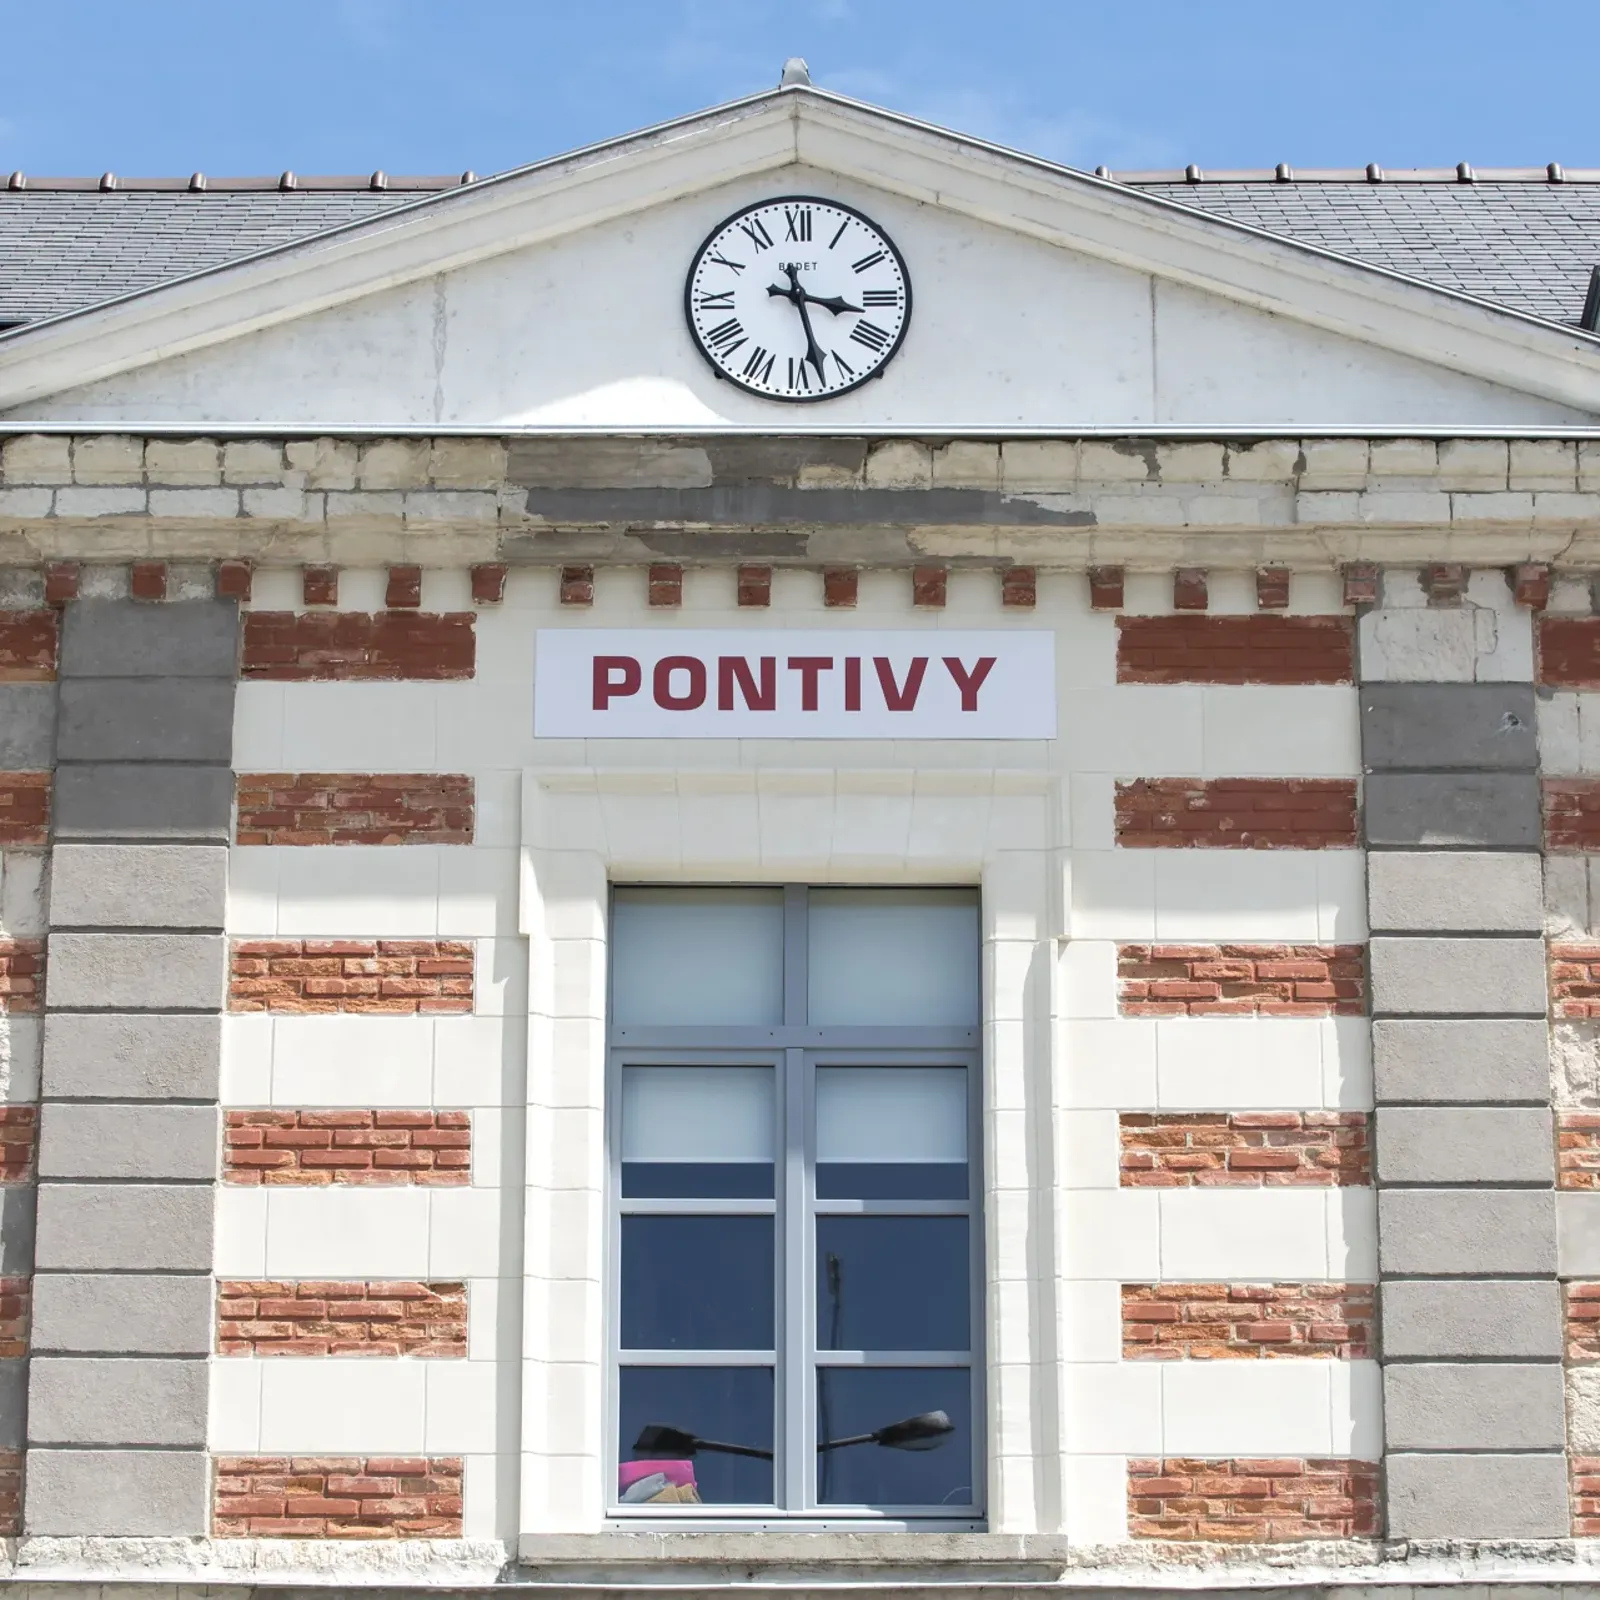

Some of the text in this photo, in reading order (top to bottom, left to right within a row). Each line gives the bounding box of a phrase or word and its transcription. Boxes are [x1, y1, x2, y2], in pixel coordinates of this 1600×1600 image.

[740, 218, 775, 254] XI
[784, 210, 812, 242] XII
[829, 221, 849, 250] I
[710, 250, 746, 276] X
[851, 250, 885, 274] II
[700, 291, 735, 310] IX
[862, 290, 898, 306] III
[706, 317, 750, 359] VIII
[849, 319, 891, 353] IIII
[743, 346, 776, 385] VII
[788, 357, 809, 389] VI
[830, 349, 855, 380] V
[592, 656, 997, 711] PONTIVY
